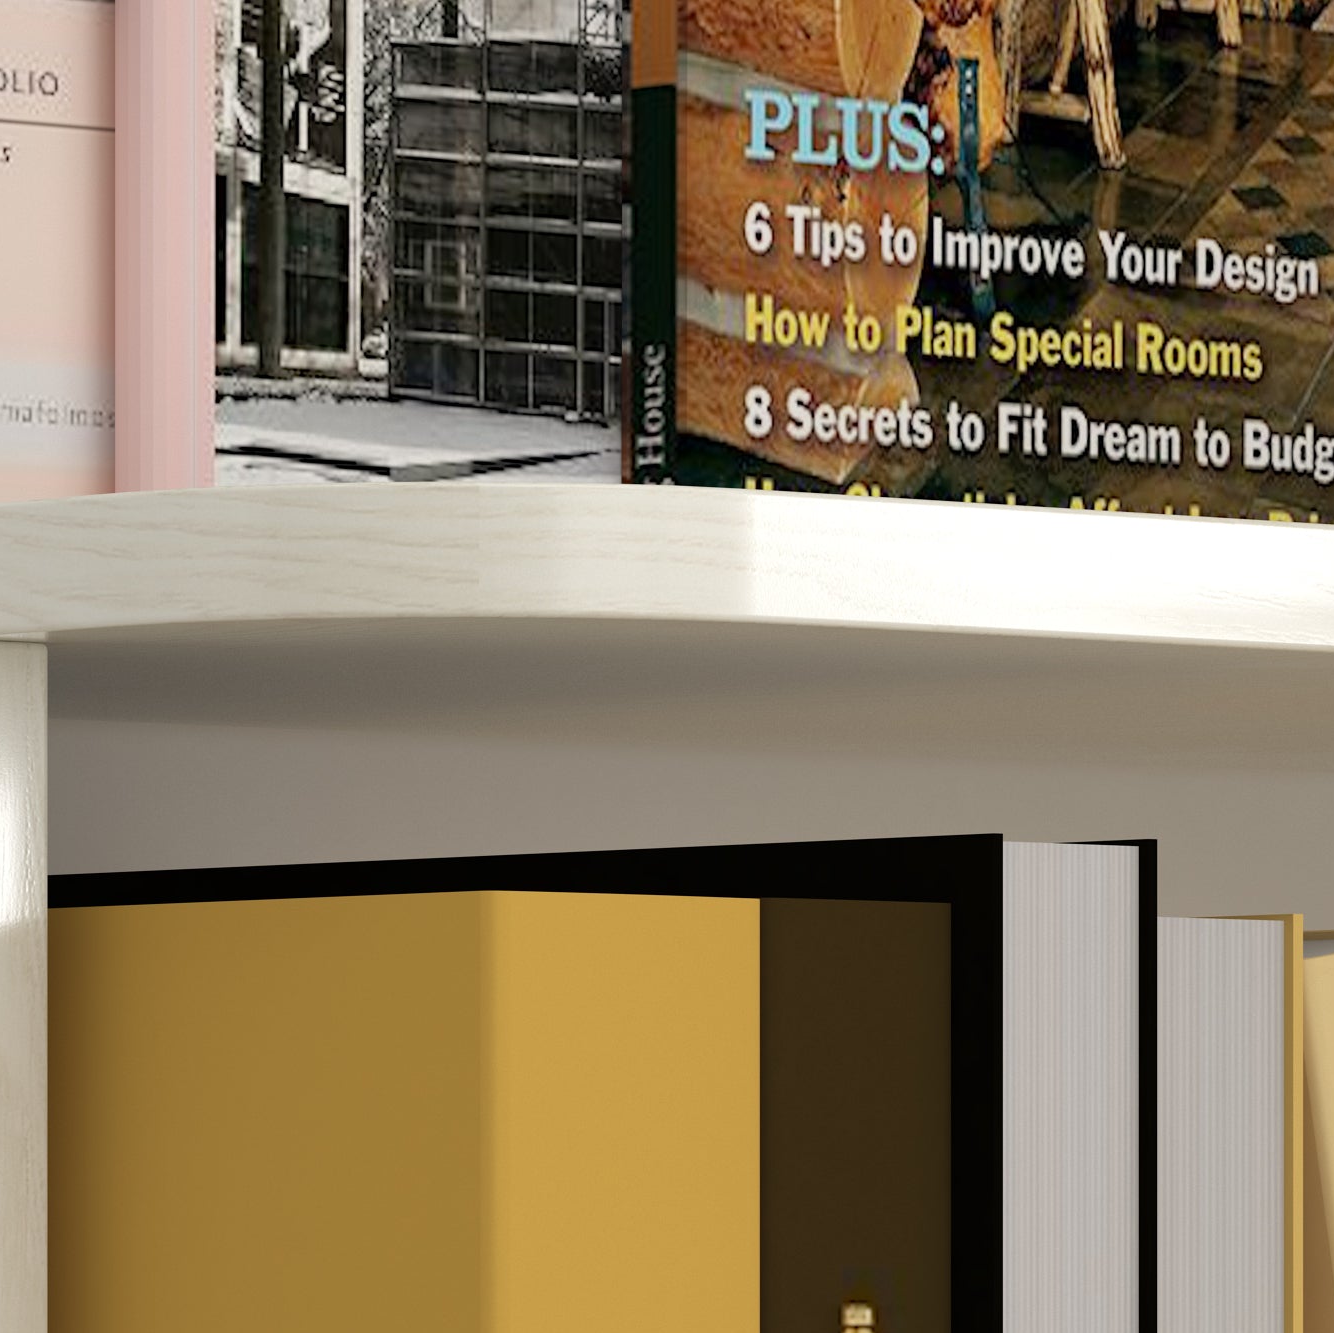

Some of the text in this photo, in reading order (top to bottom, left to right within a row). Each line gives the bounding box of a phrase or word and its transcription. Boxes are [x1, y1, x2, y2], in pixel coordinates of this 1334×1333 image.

[745, 89, 946, 177] PLUS:
[744, 201, 1319, 304] 6 Tips to Improve Your Design
[744, 293, 1264, 382] How to Plan Special Rooms
[636, 343, 667, 468] House
[744, 385, 774, 439] 8
[786, 386, 934, 449] Secrets
[946, 400, 986, 451] to
[997, 402, 1049, 457] Fit
[1060, 405, 1181, 466] Dream
[1194, 416, 1232, 469] to
